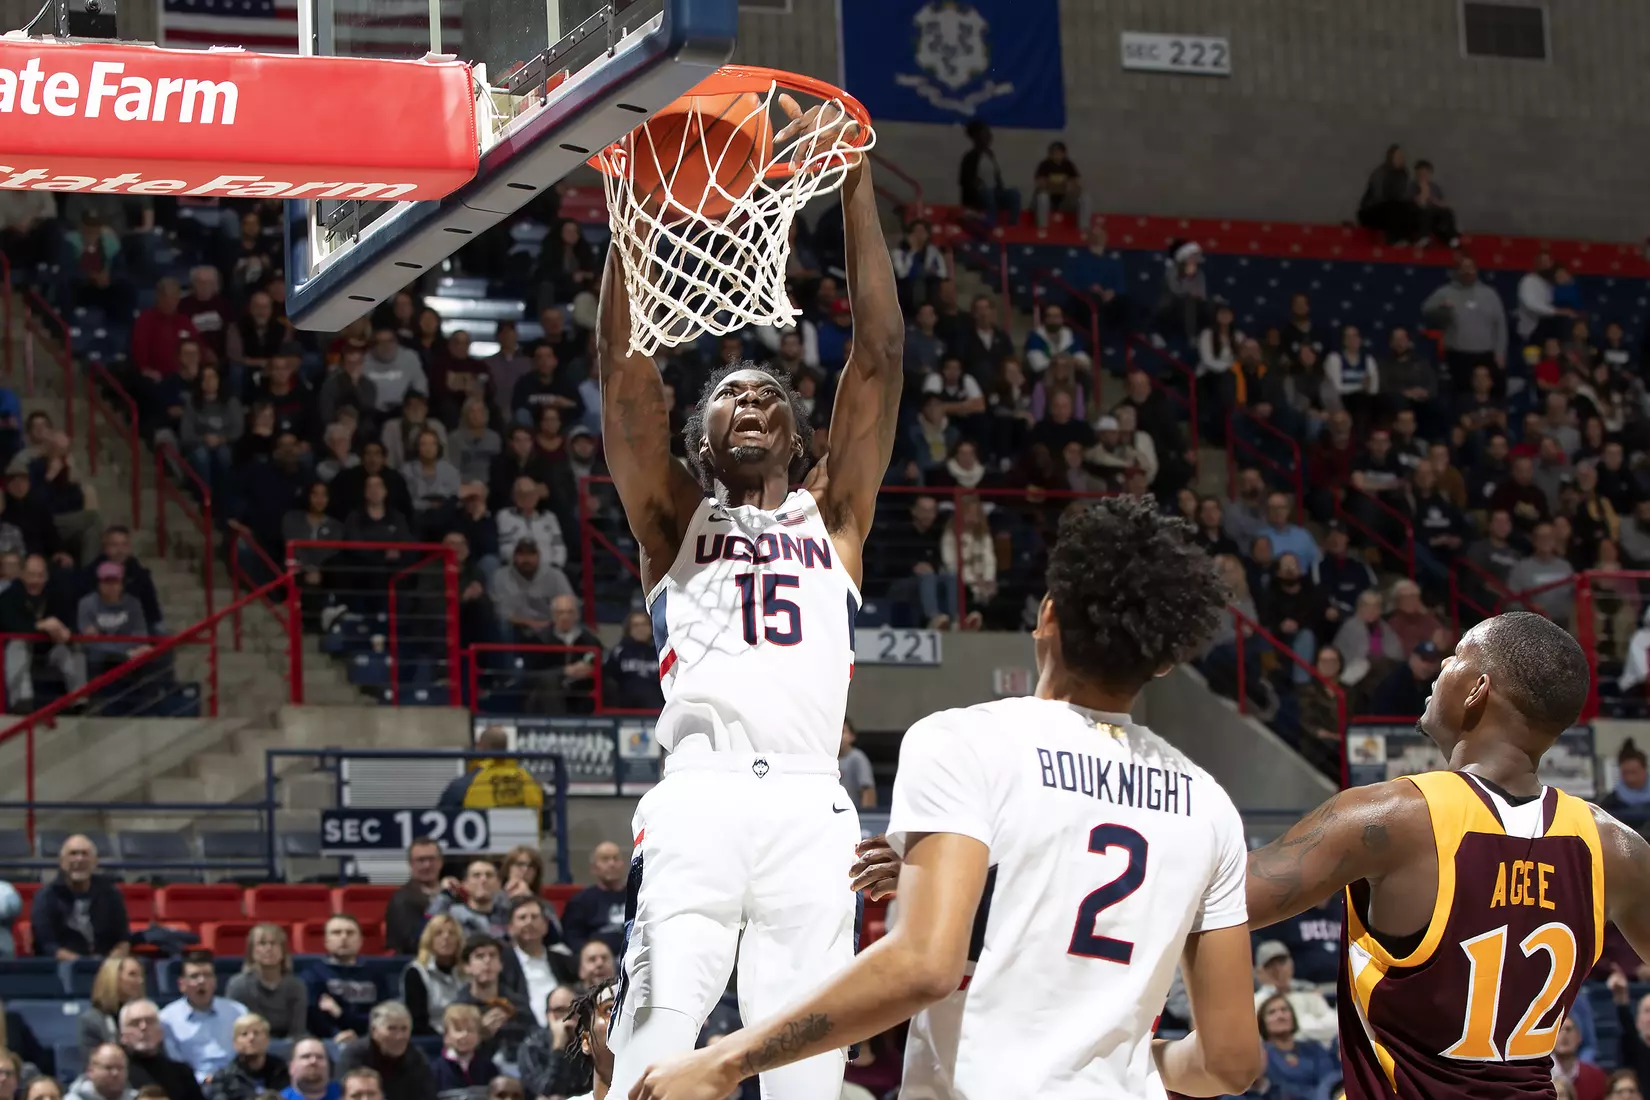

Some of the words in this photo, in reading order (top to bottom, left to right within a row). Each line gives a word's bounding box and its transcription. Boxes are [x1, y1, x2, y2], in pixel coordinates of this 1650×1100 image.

[1169, 40, 1226, 67] 222
[84, 61, 239, 125] Farm
[181, 175, 418, 198] Farm
[695, 532, 832, 569] UCONN
[735, 572, 803, 647] 15
[878, 631, 938, 662] 221
[1036, 747, 1193, 816] BOUKNIGHT
[324, 818, 381, 842] SEC
[394, 810, 487, 850] 120
[1067, 822, 1149, 965] 2
[1490, 859, 1556, 910] AGEE
[1438, 921, 1577, 1062] 12
